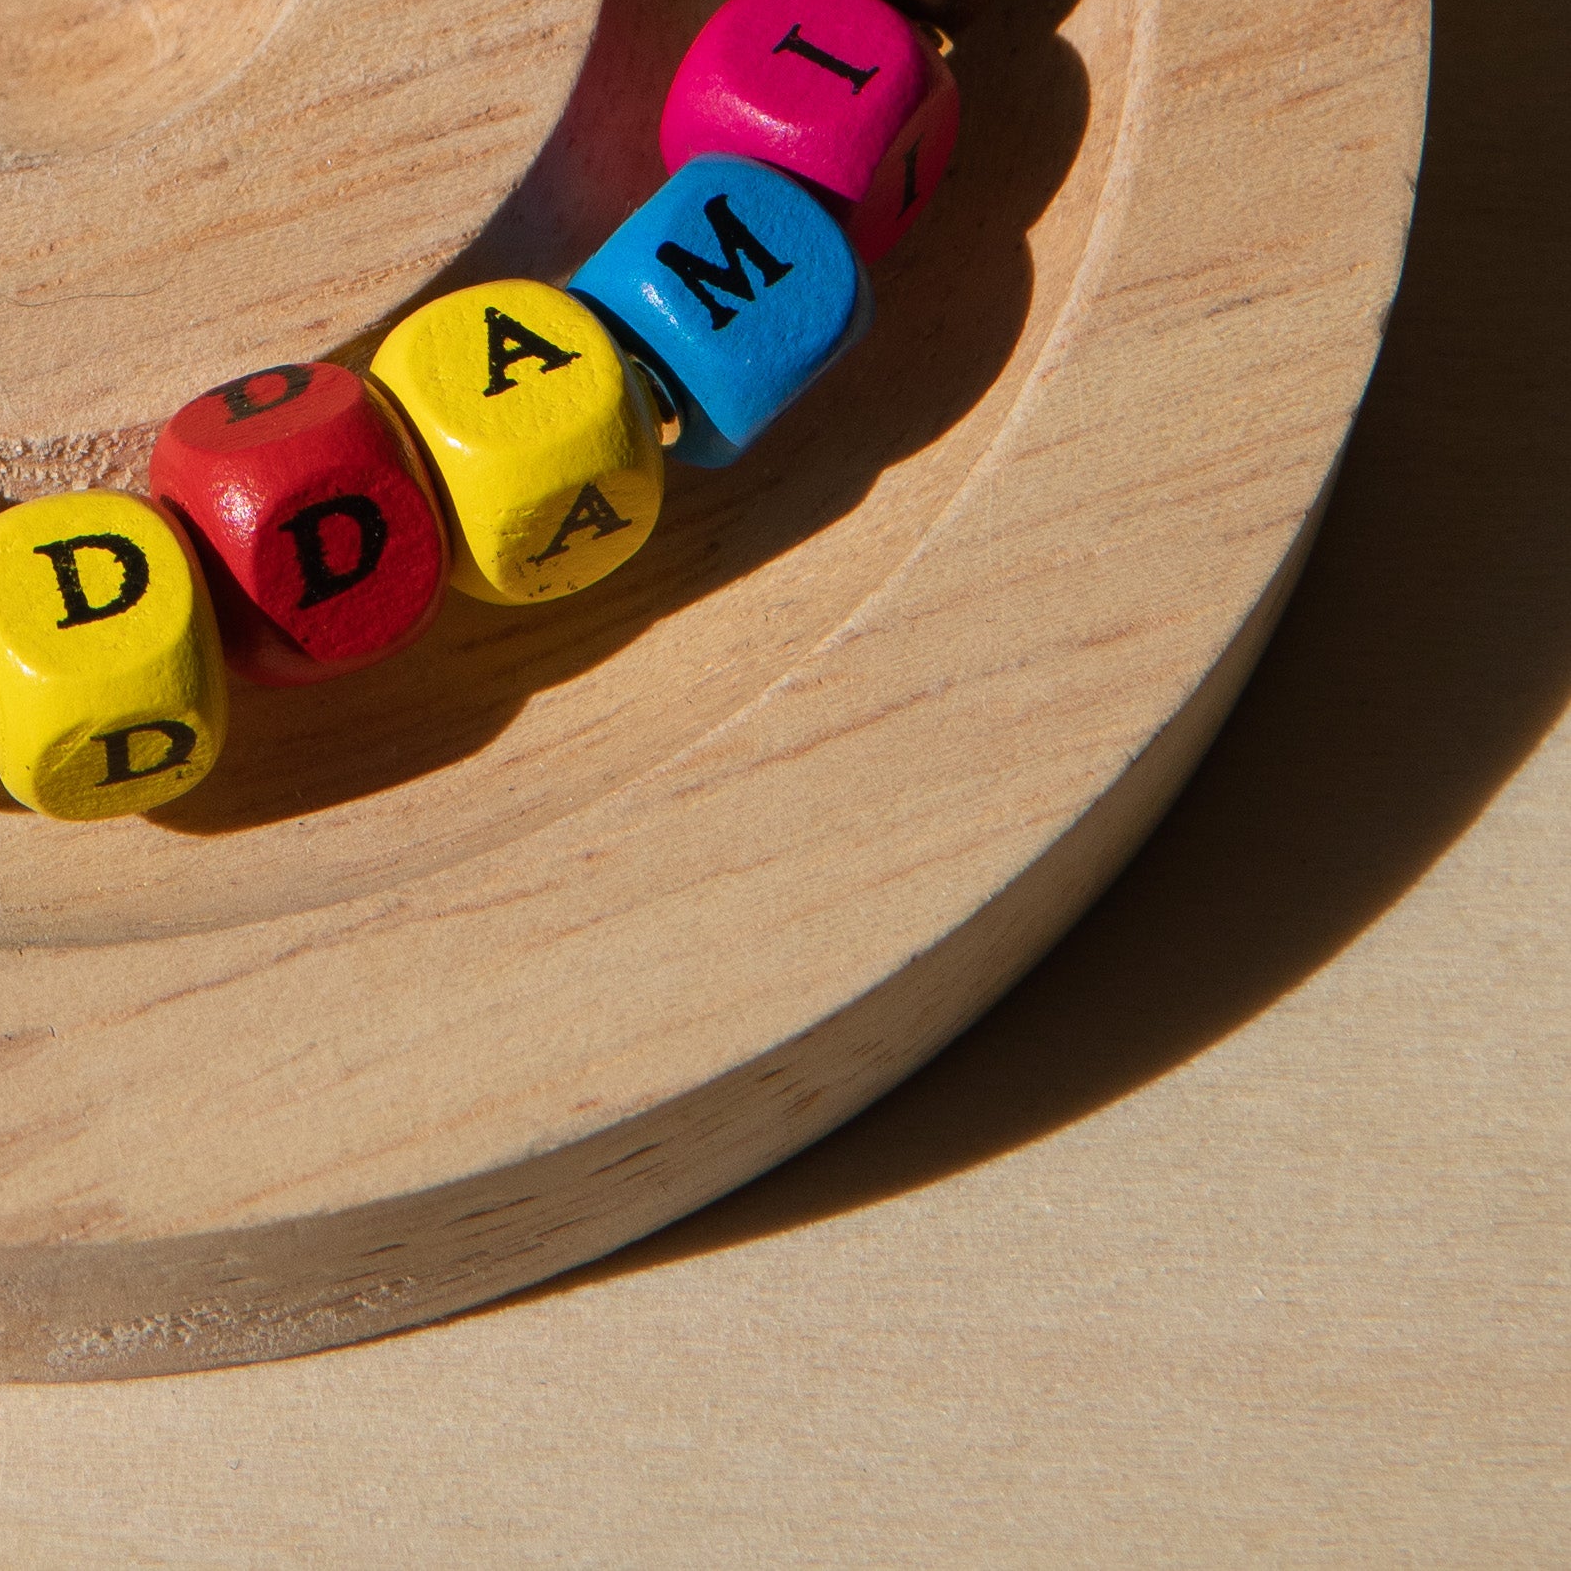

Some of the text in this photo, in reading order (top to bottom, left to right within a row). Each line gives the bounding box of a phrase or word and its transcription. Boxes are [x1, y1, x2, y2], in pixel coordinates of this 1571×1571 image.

[771, 22, 880, 95] I
[655, 192, 794, 331] M
[482, 306, 582, 397] A
[278, 493, 389, 610] D
[526, 481, 632, 567] A
[32, 532, 151, 629] D
[89, 719, 197, 787] D
